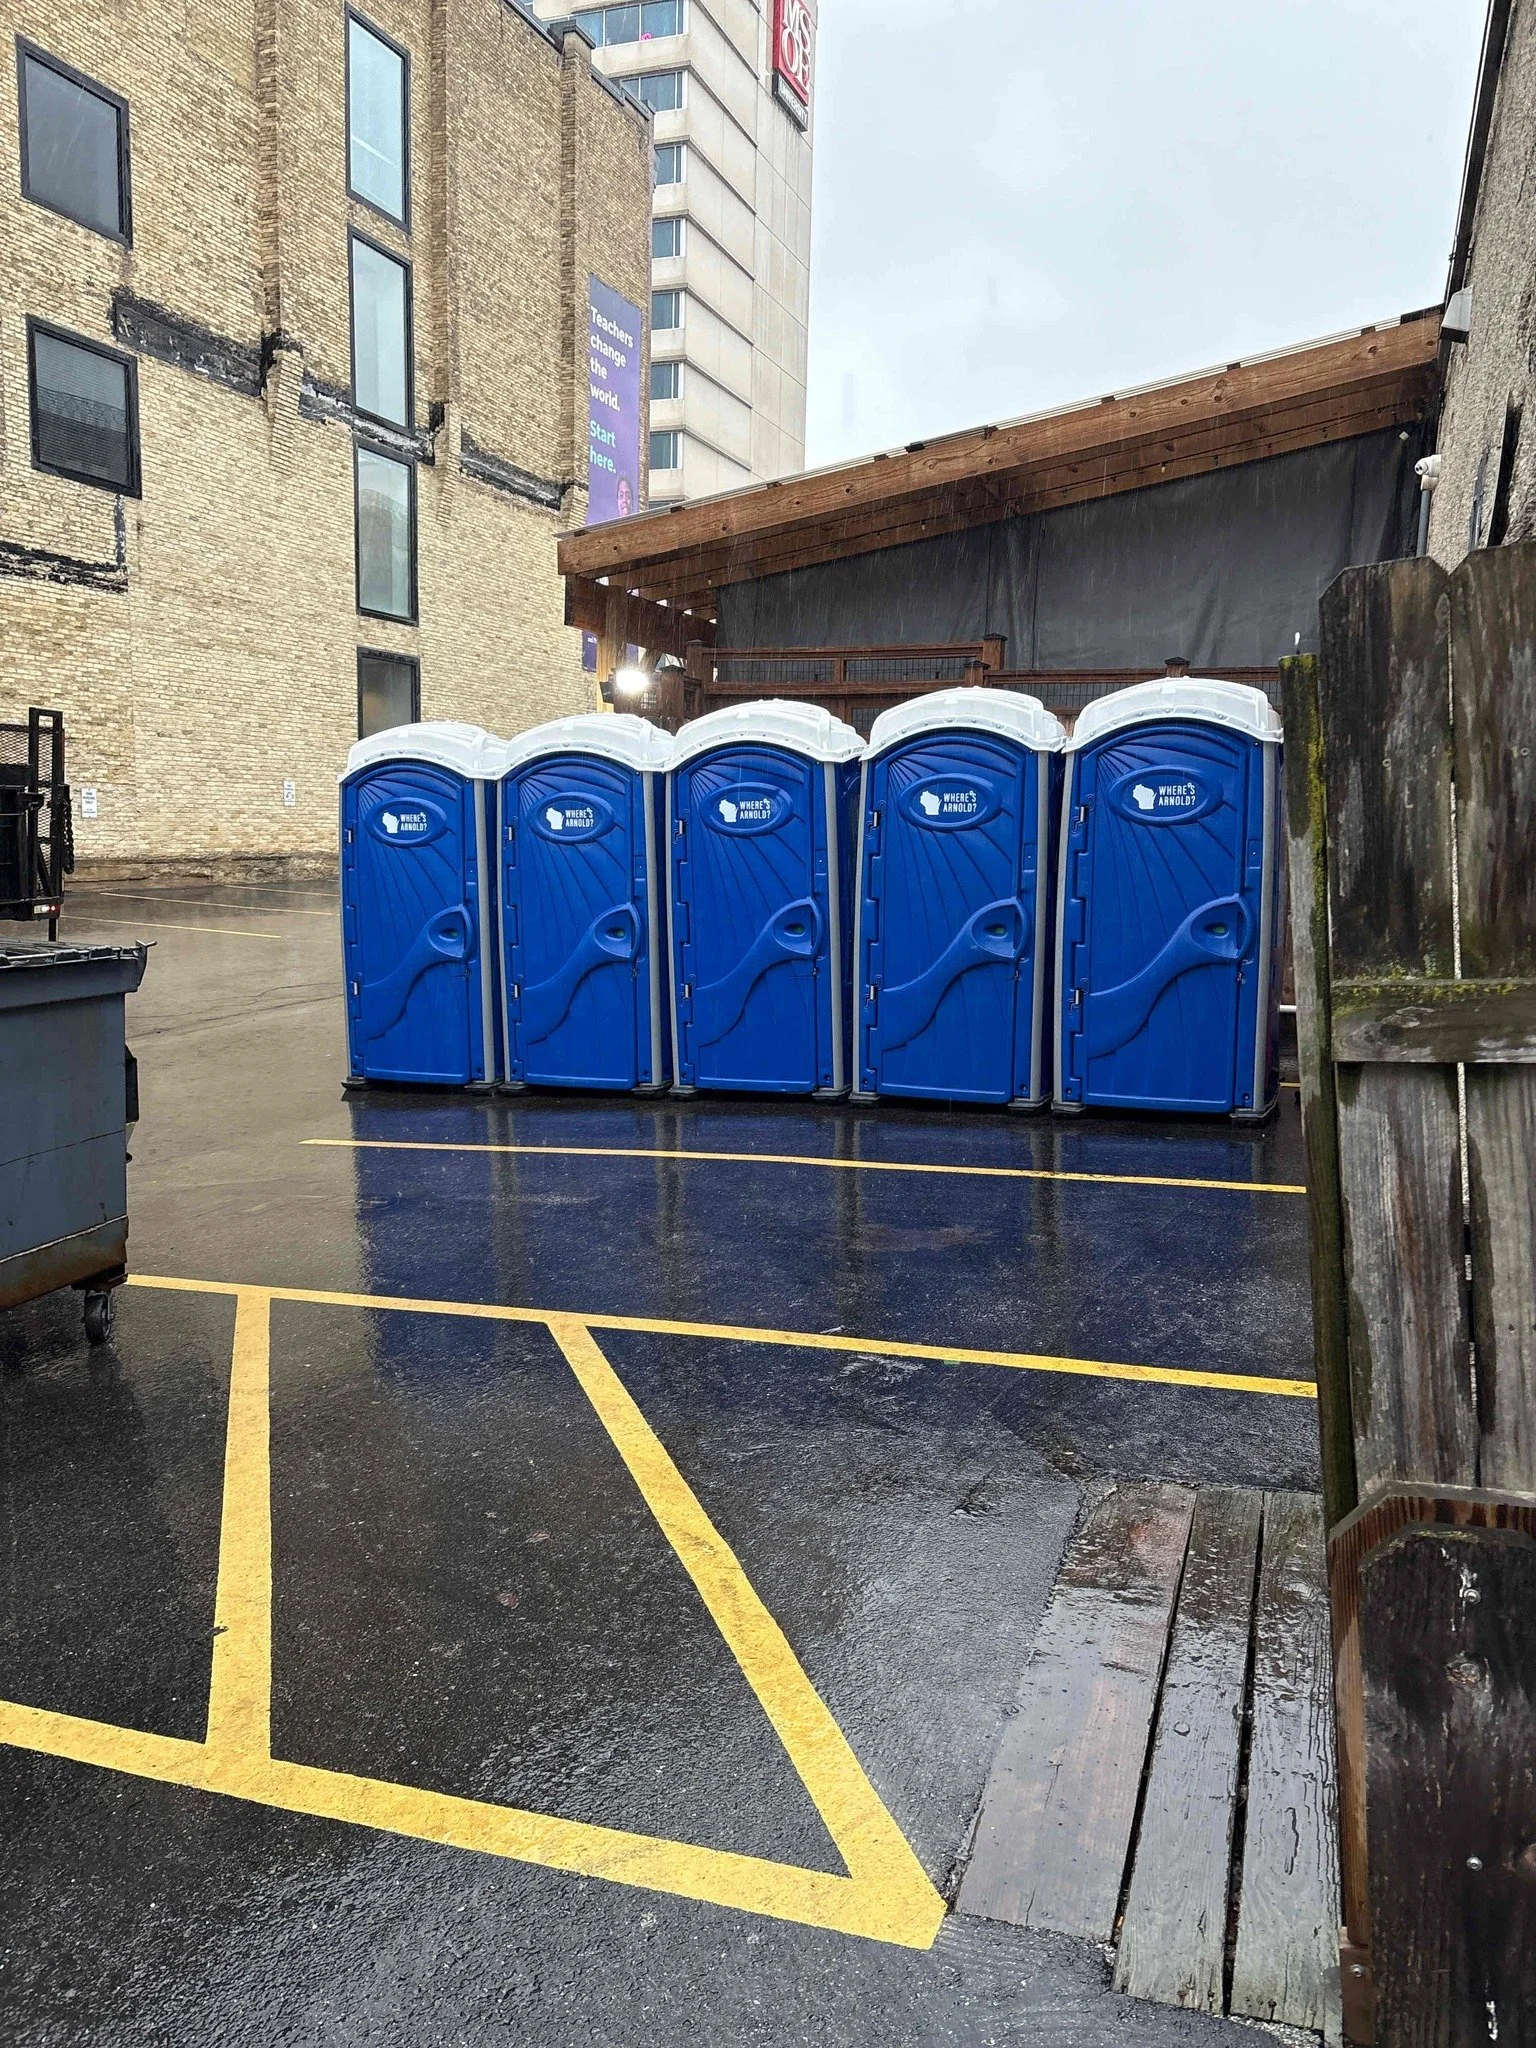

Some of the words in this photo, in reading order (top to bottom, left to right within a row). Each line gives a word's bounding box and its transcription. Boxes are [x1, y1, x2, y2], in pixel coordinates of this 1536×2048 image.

[590, 305, 633, 348] Teachers
[590, 334, 627, 368] change
[590, 357, 608, 380] the
[590, 383, 620, 412] world.
[590, 420, 616, 448] Start
[590, 445, 616, 474] here.
[943, 803, 977, 813] ARNOLD?
[1158, 795, 1196, 807] ARNOLD?
[565, 818, 594, 828] ARNOLD?
[739, 810, 771, 820] ARNOLD?
[400, 823, 428, 832] ARNOLD?
